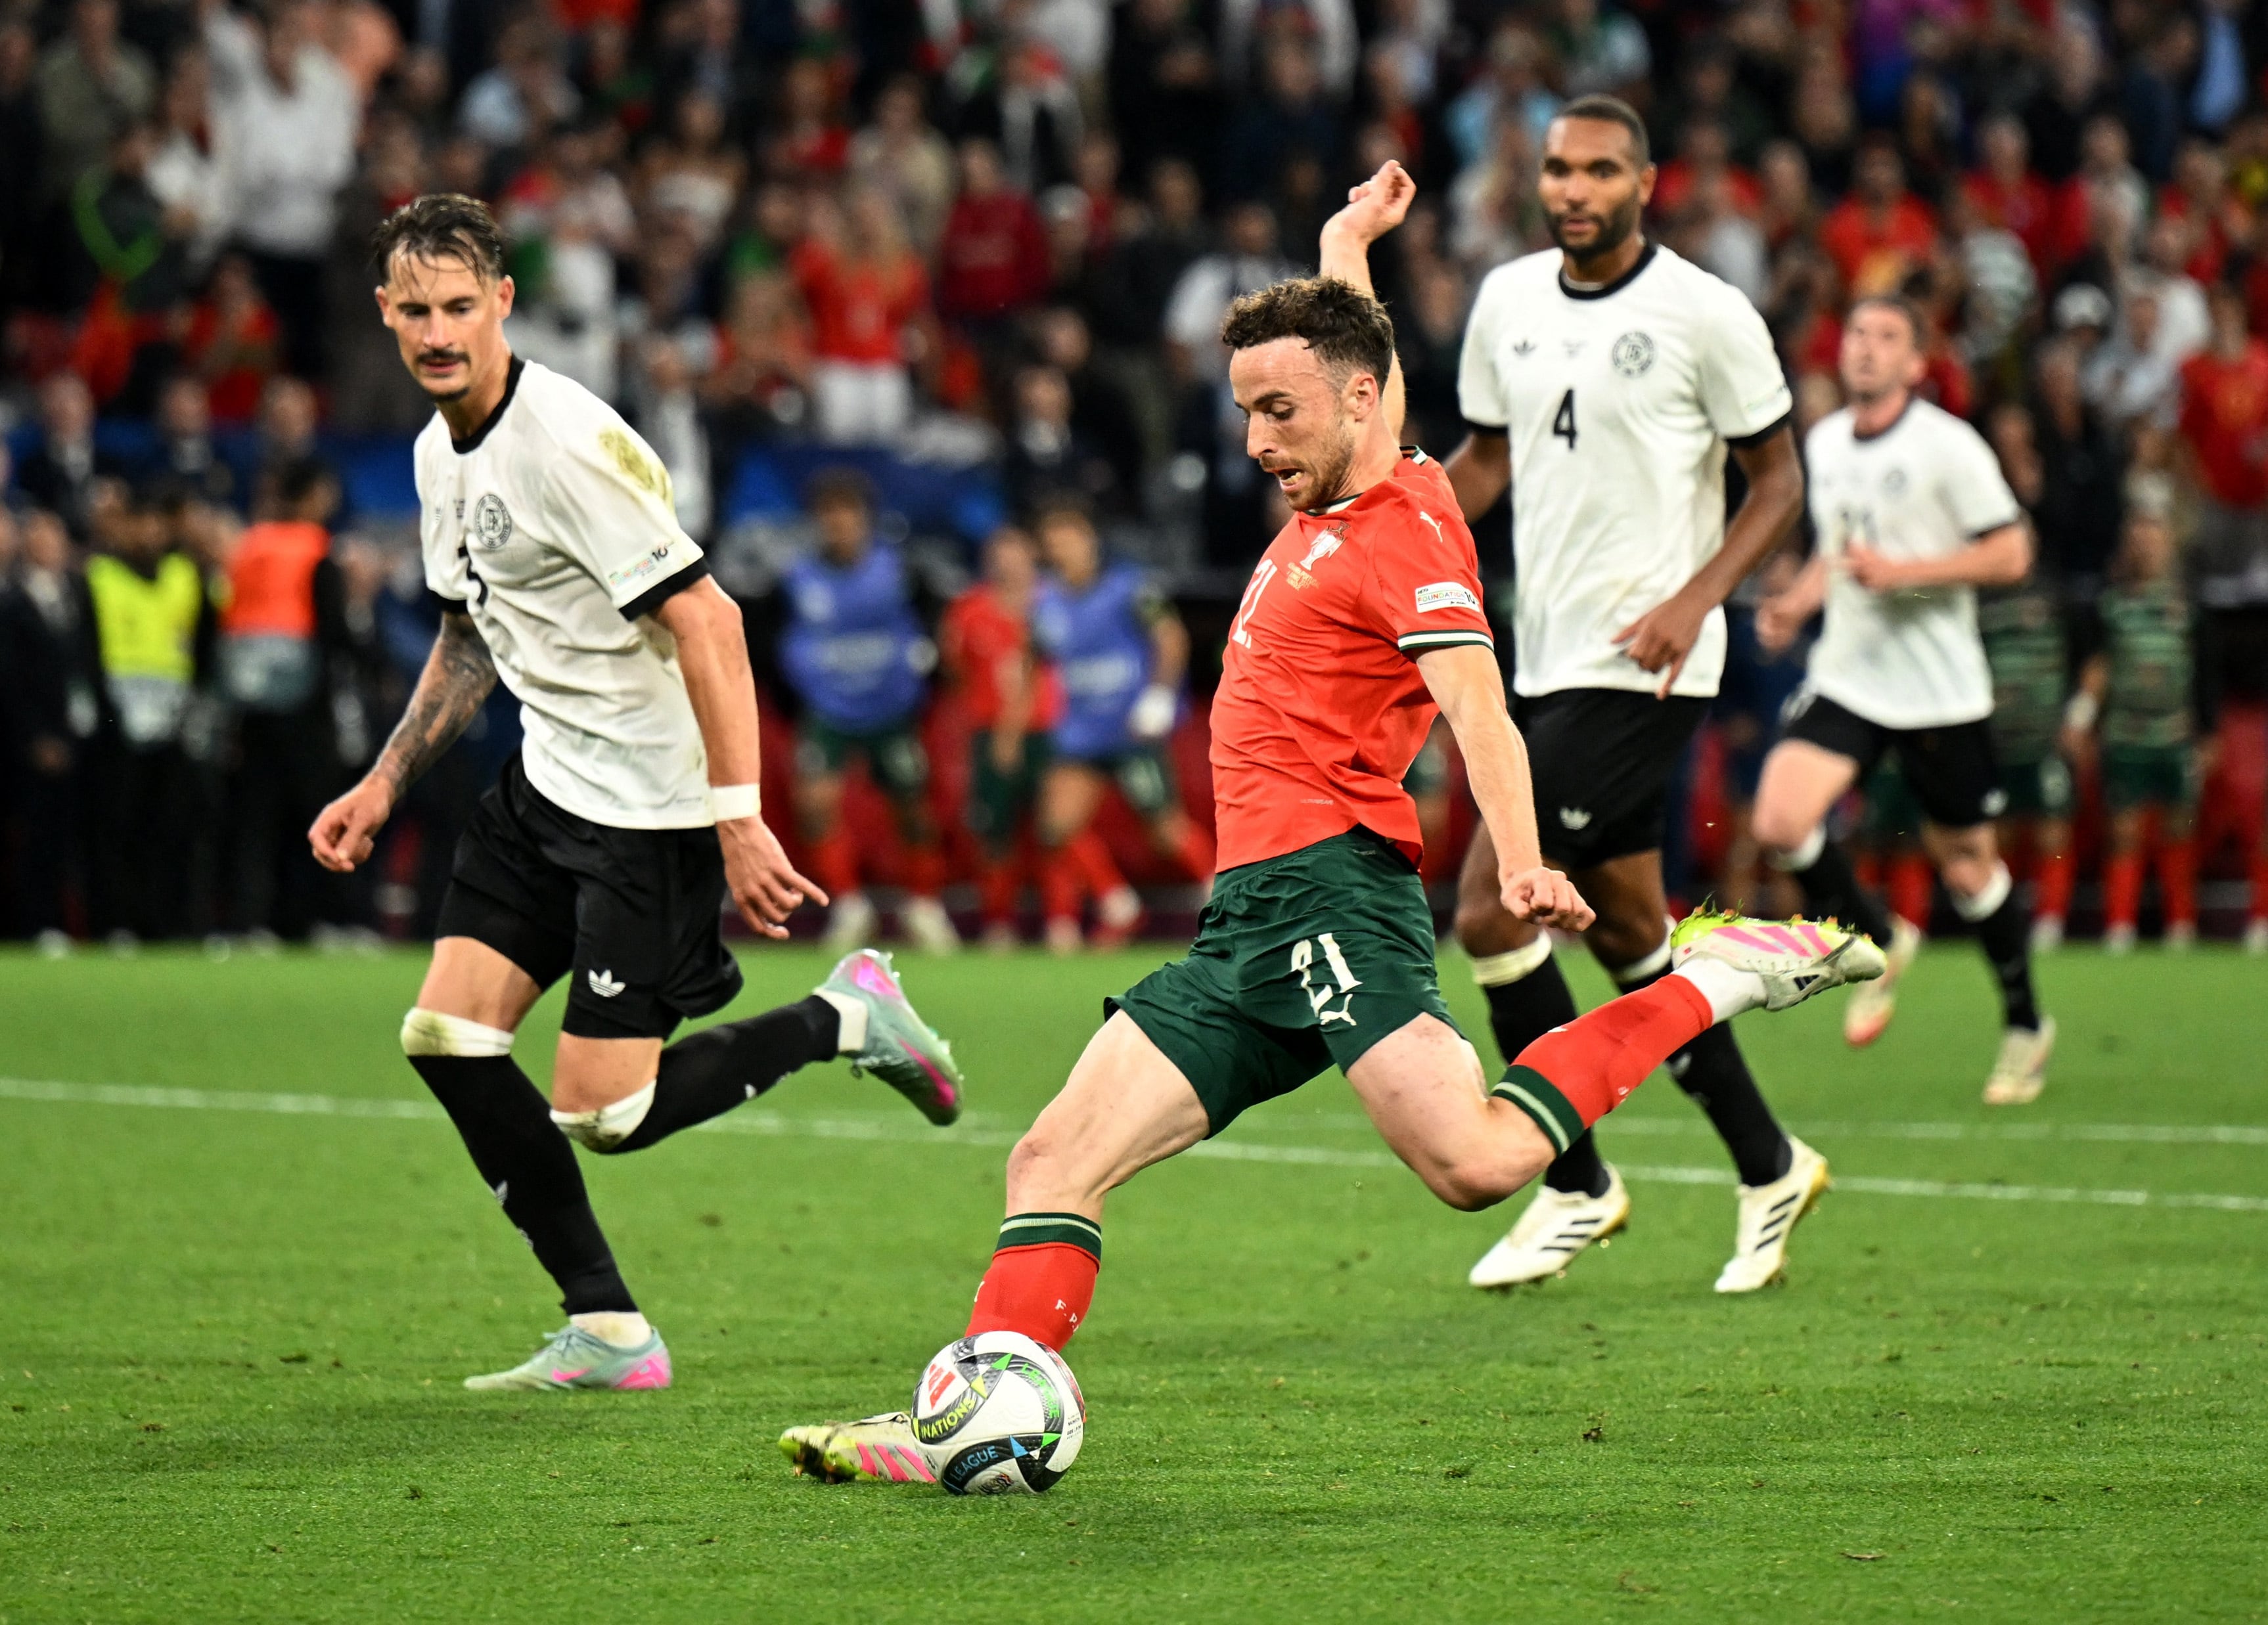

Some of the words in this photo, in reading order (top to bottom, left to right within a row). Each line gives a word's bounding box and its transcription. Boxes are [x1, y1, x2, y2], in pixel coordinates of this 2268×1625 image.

[1553, 388, 1579, 451] 4
[1232, 558, 1278, 650] 21
[1418, 591, 1466, 603] FOUNDATION
[1291, 933, 1363, 1018] 21
[920, 1397, 976, 1439] NATIONS
[950, 1446, 999, 1481] LEAGUE
